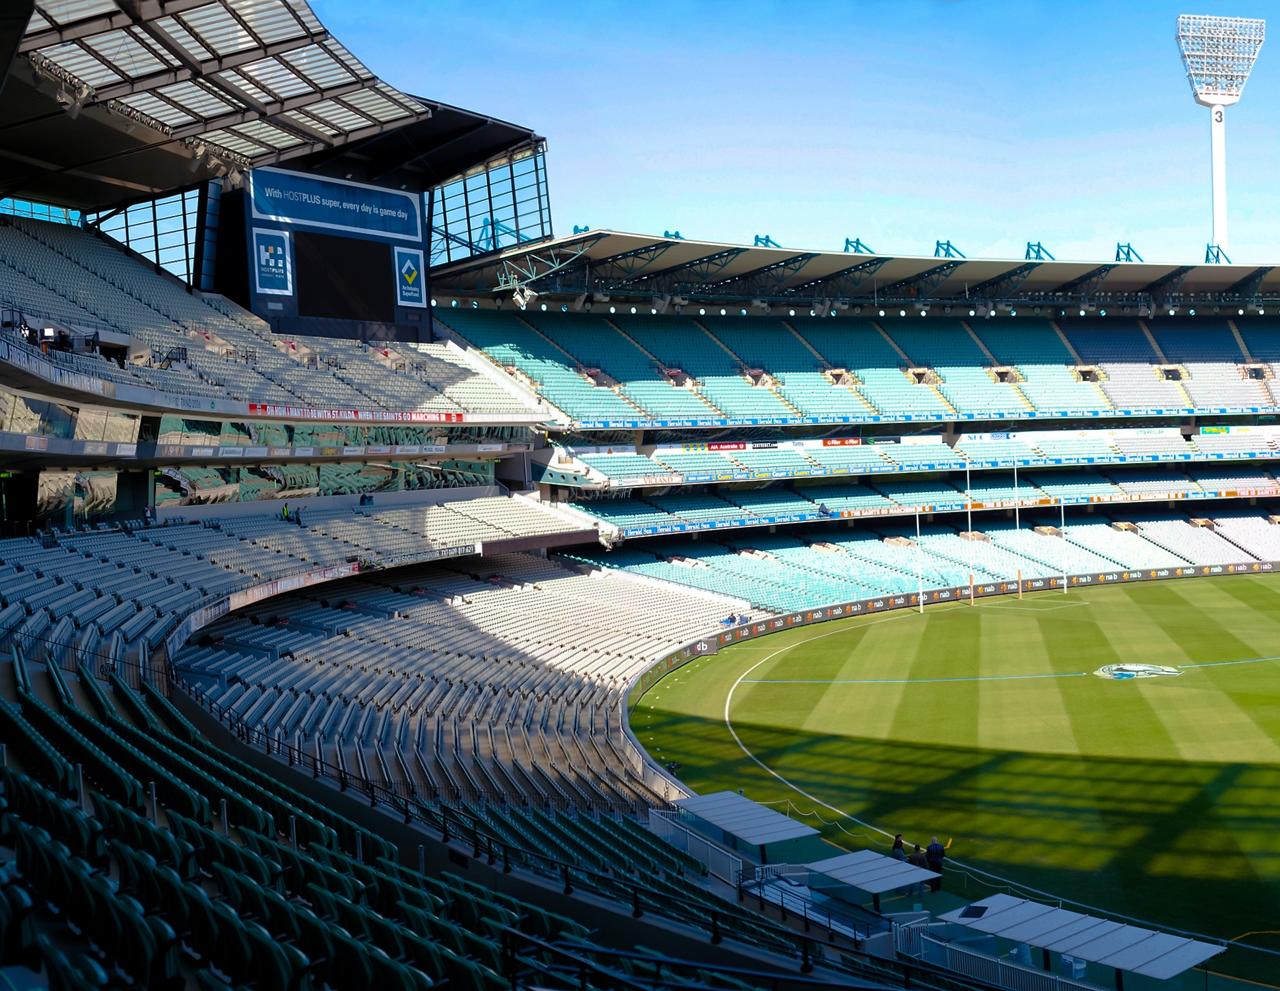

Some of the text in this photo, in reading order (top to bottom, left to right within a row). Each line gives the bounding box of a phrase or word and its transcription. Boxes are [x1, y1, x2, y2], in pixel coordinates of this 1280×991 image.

[1215, 111, 1223, 123] 3
[265, 187, 282, 198] With
[283, 190, 320, 204] HOSTPLUS
[322, 199, 341, 208] super,
[343, 202, 359, 212] every
[361, 203, 372, 214] day
[373, 205, 378, 213] is
[397, 210, 408, 220] day
[411, 412, 439, 421] MARCHING
